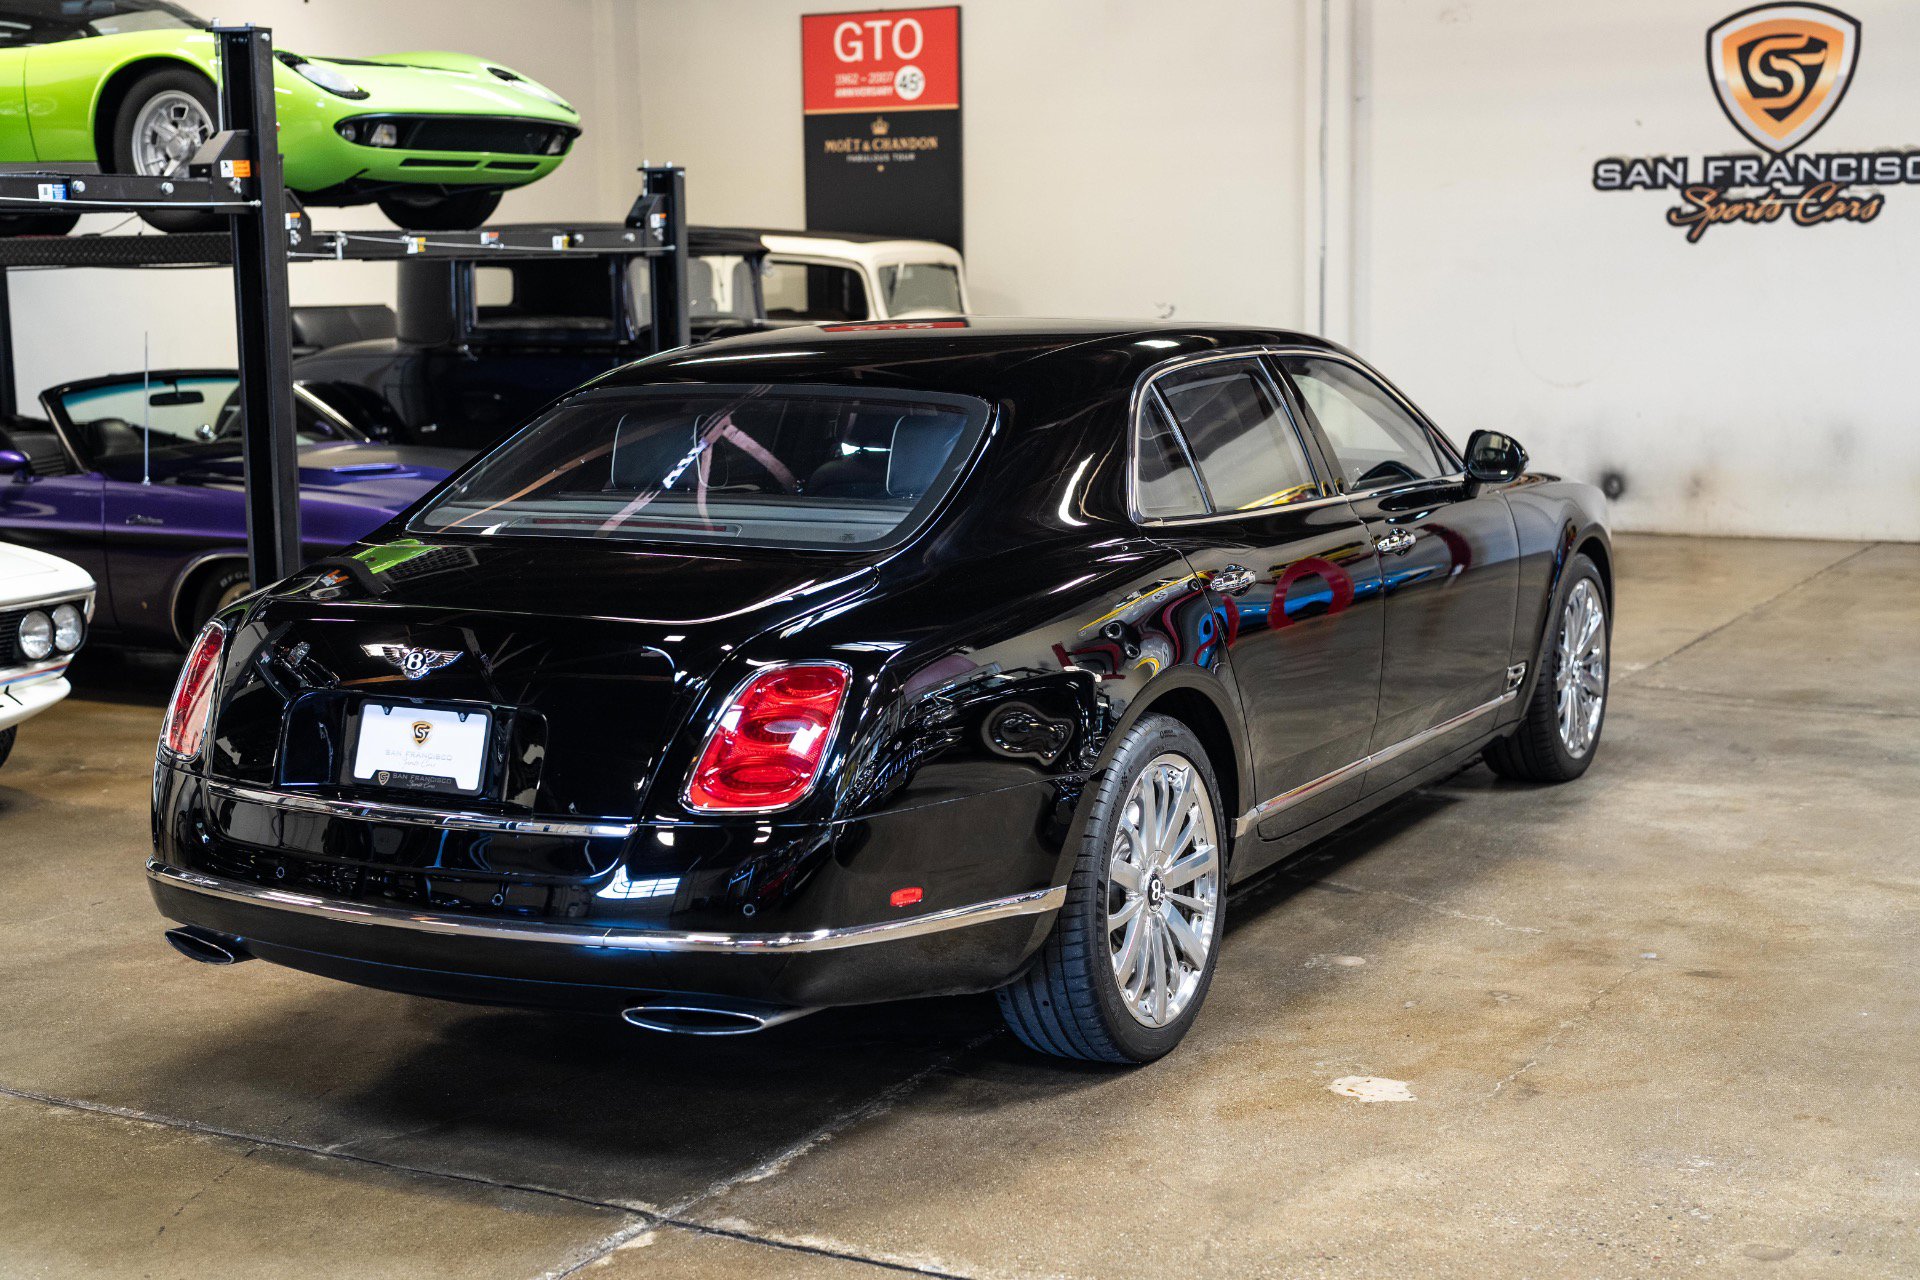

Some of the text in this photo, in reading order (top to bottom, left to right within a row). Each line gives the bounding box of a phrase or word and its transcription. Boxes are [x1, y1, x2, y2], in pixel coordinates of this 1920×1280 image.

[833, 18, 924, 63] GTO
[871, 136, 939, 152] CHANDON
[1595, 156, 1687, 189] SAN
[1668, 181, 1883, 242] Sports Cars
[405, 751, 453, 761] FRANCISCO
[410, 774, 452, 784] FRANCISCO
